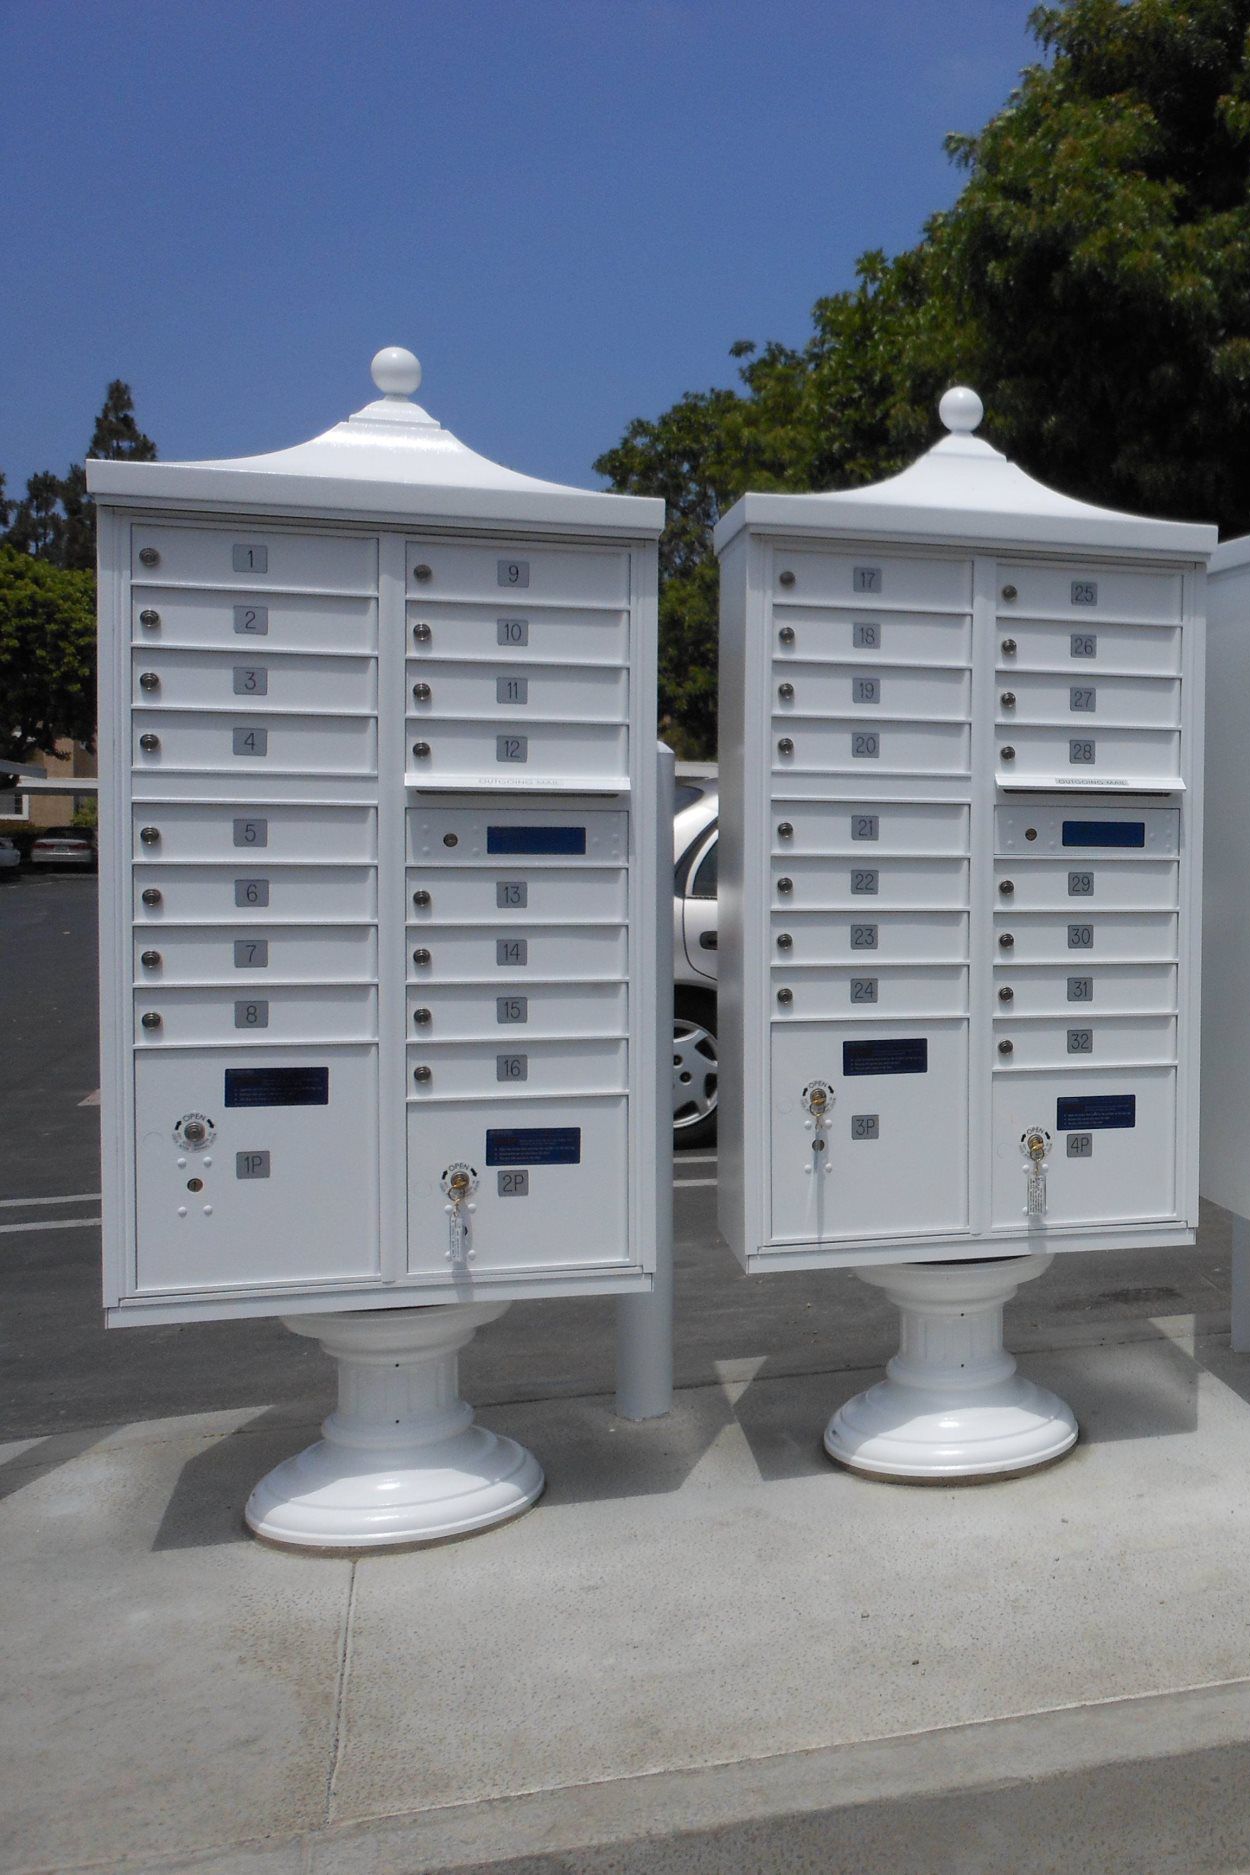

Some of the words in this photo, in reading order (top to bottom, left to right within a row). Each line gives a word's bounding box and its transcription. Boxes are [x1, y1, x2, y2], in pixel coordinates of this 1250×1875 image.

[509, 565, 519, 583] 9
[861, 572, 875, 588] 17
[1075, 586, 1093, 602] 25
[245, 611, 256, 629] 2
[505, 624, 521, 641] 10
[860, 627, 875, 644] 18
[1075, 638, 1092, 655] 26
[245, 672, 256, 690] 3
[508, 682, 518, 699] 11
[860, 682, 874, 699] 19
[1074, 691, 1092, 707] 27
[244, 733, 255, 750] 4
[504, 740, 520, 758] 12
[856, 737, 876, 754] 20
[1074, 744, 1091, 760] 28
[245, 824, 256, 842] 5
[858, 819, 873, 836] 21
[856, 873, 874, 890] 22
[1072, 876, 1090, 892] 29
[247, 884, 258, 902] 6
[504, 886, 520, 903] 13
[855, 929, 874, 945] 23
[1072, 928, 1090, 944] 30
[246, 945, 256, 962] 7
[504, 944, 520, 960] 14
[855, 982, 873, 998] 24
[1074, 982, 1087, 997] 31
[246, 1006, 257, 1023] 8
[504, 1002, 520, 1019] 15
[1072, 1034, 1088, 1049] 32
[504, 1060, 520, 1076] 16
[808, 1080, 827, 1089] OPEN
[183, 1113, 206, 1121] OPEN
[856, 1119, 875, 1135] 3P
[1026, 1126, 1044, 1134] OPEN
[1071, 1137, 1089, 1152] 4P
[245, 1156, 262, 1173] 1P
[448, 1162, 469, 1172] OPEN
[503, 1175, 524, 1192] 2P
